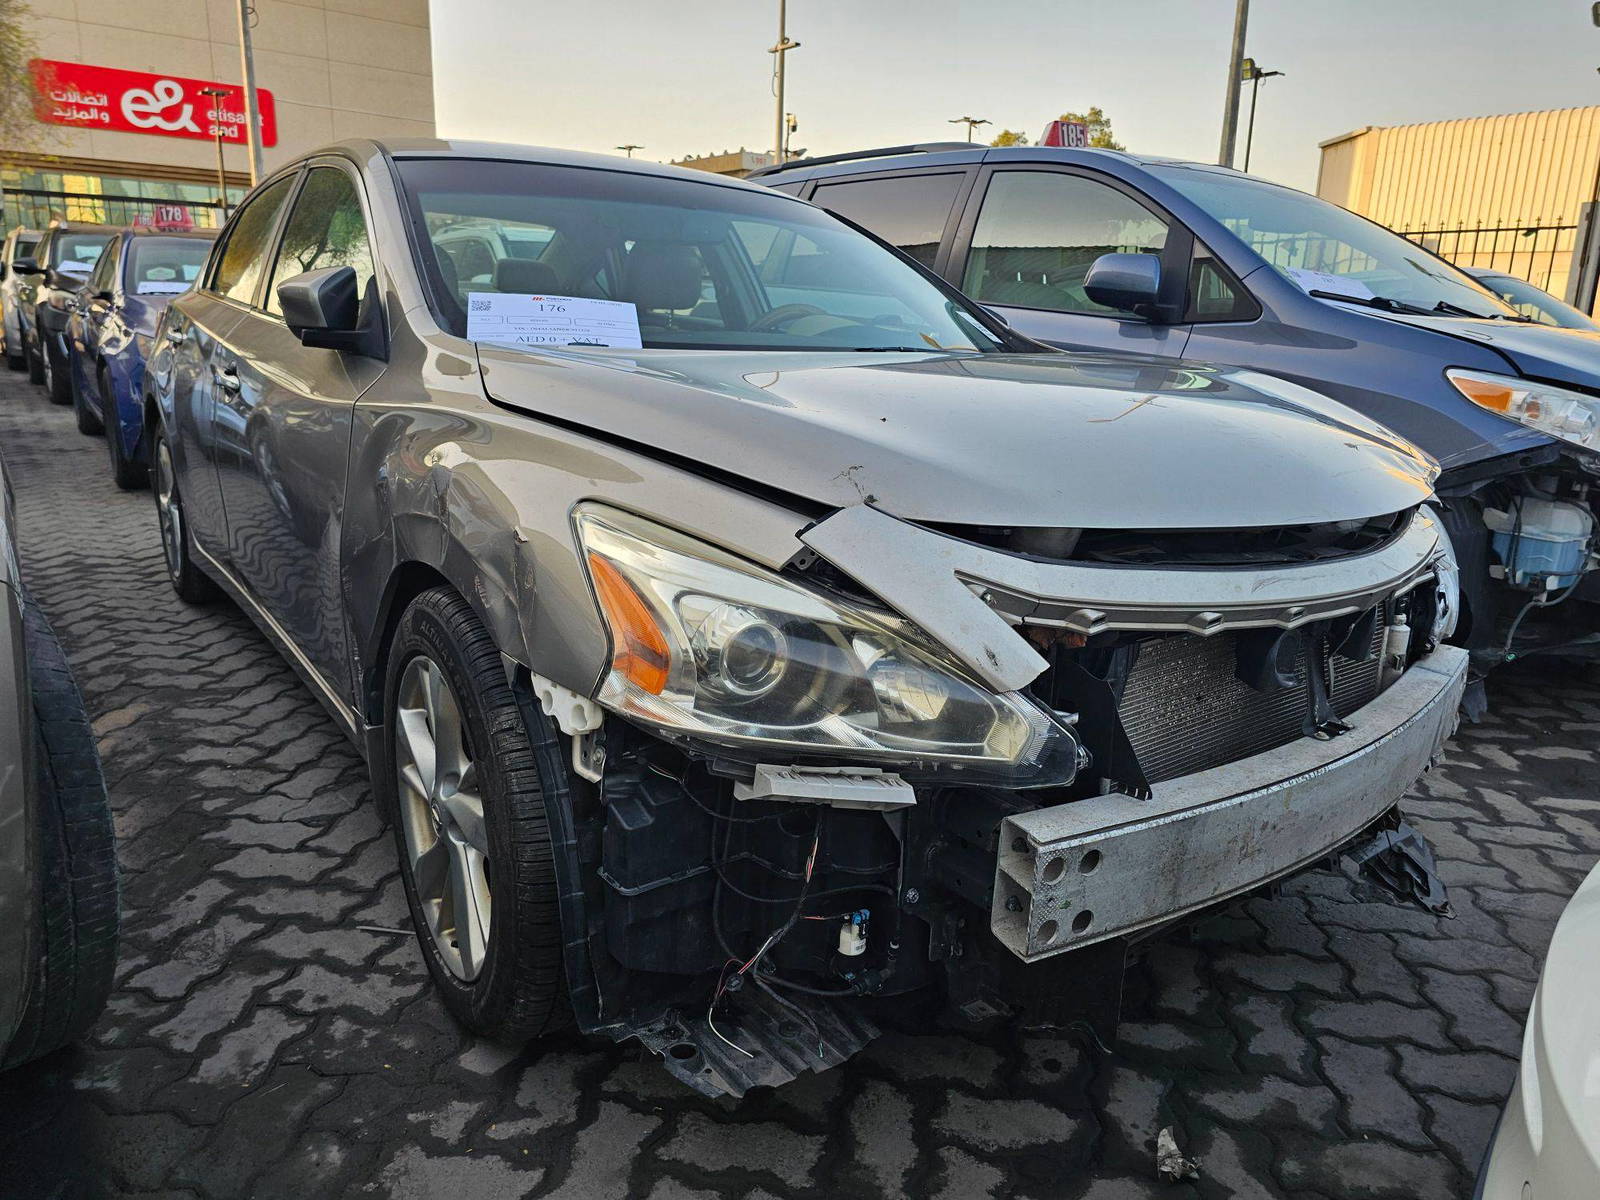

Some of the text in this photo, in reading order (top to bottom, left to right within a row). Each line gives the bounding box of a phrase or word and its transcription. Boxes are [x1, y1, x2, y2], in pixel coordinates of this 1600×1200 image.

[50, 91, 108, 106] اتصالات
[1062, 124, 1085, 147] 185
[160, 207, 182, 222] 178
[539, 303, 567, 313] 176
